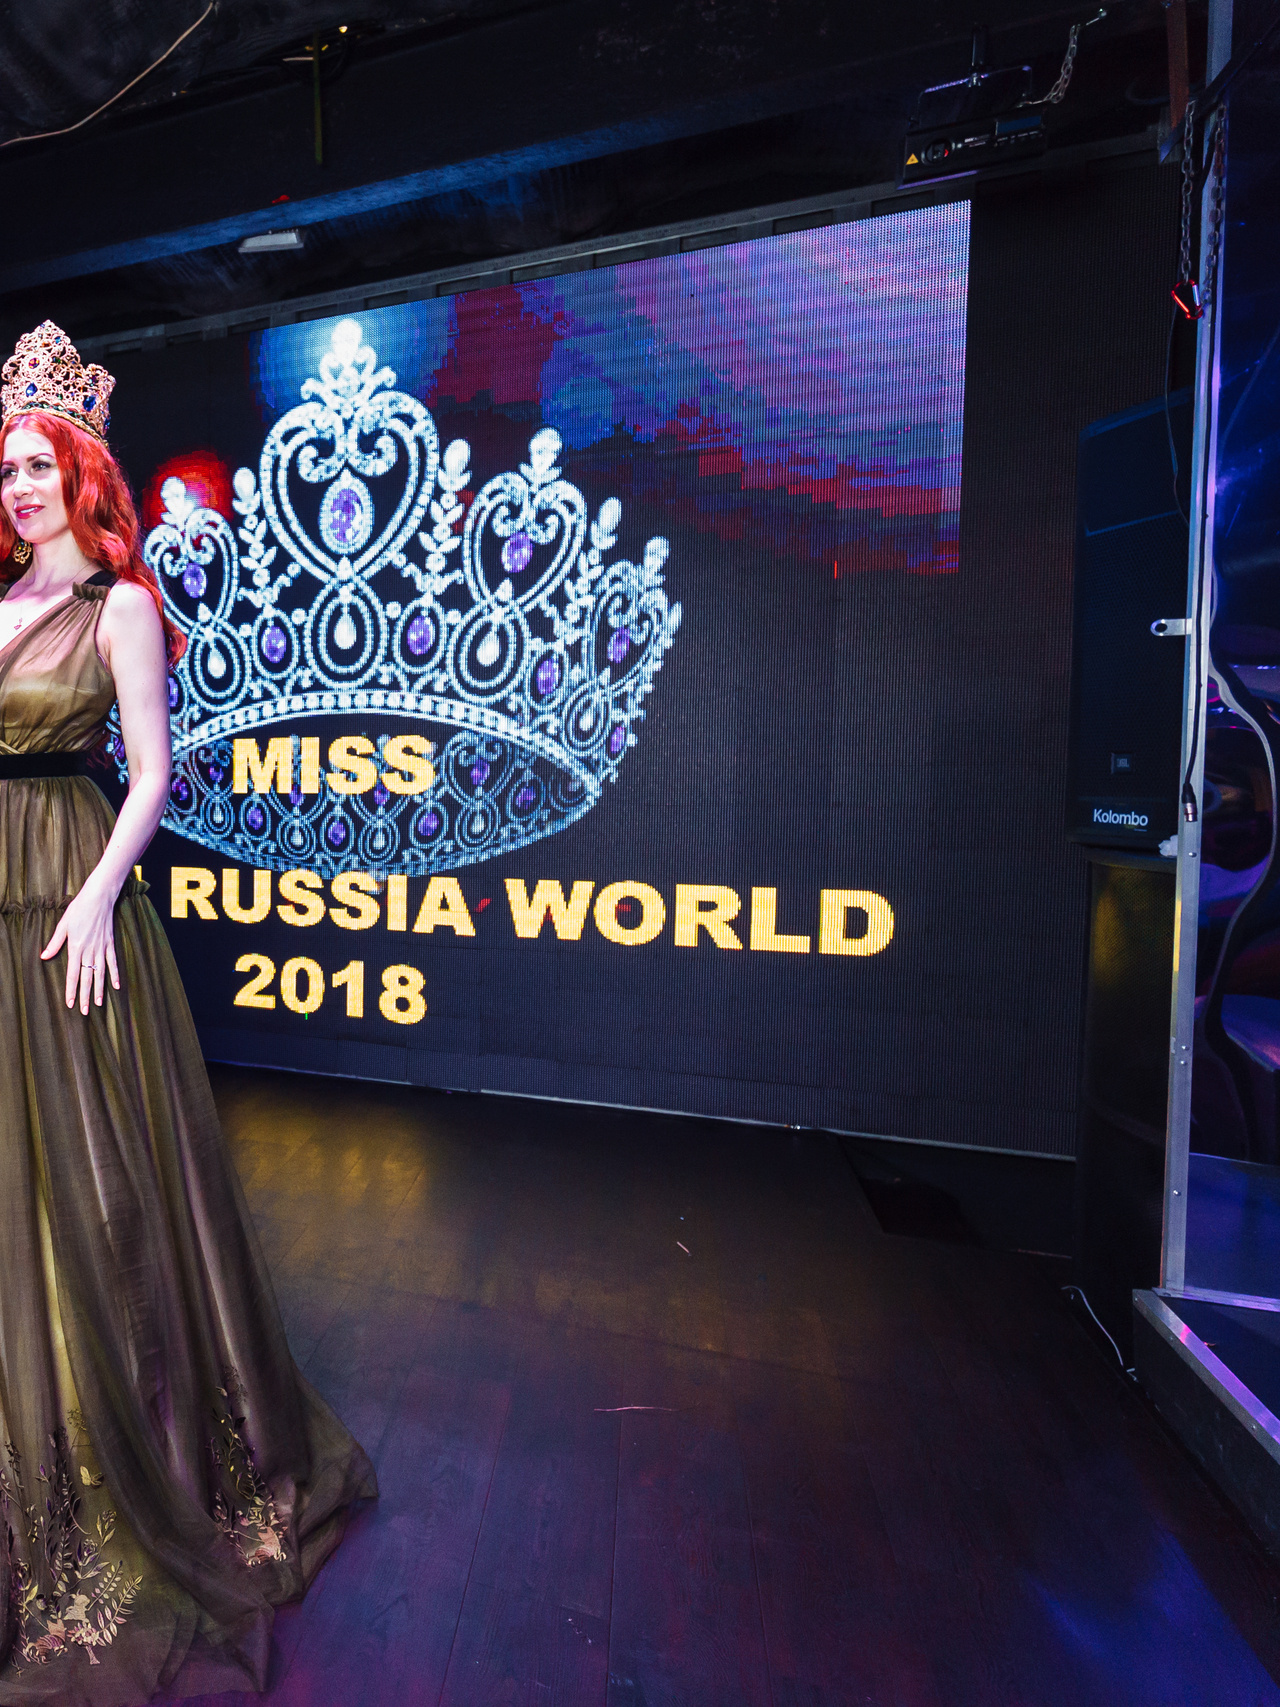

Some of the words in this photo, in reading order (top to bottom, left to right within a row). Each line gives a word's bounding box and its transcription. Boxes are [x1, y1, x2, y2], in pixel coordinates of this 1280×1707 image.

[233, 735, 436, 795] MISS
[1093, 808, 1149, 827] Kolombo
[170, 866, 476, 937] RUSSIA
[504, 878, 895, 957] WORLD
[233, 953, 427, 1025] 2018
